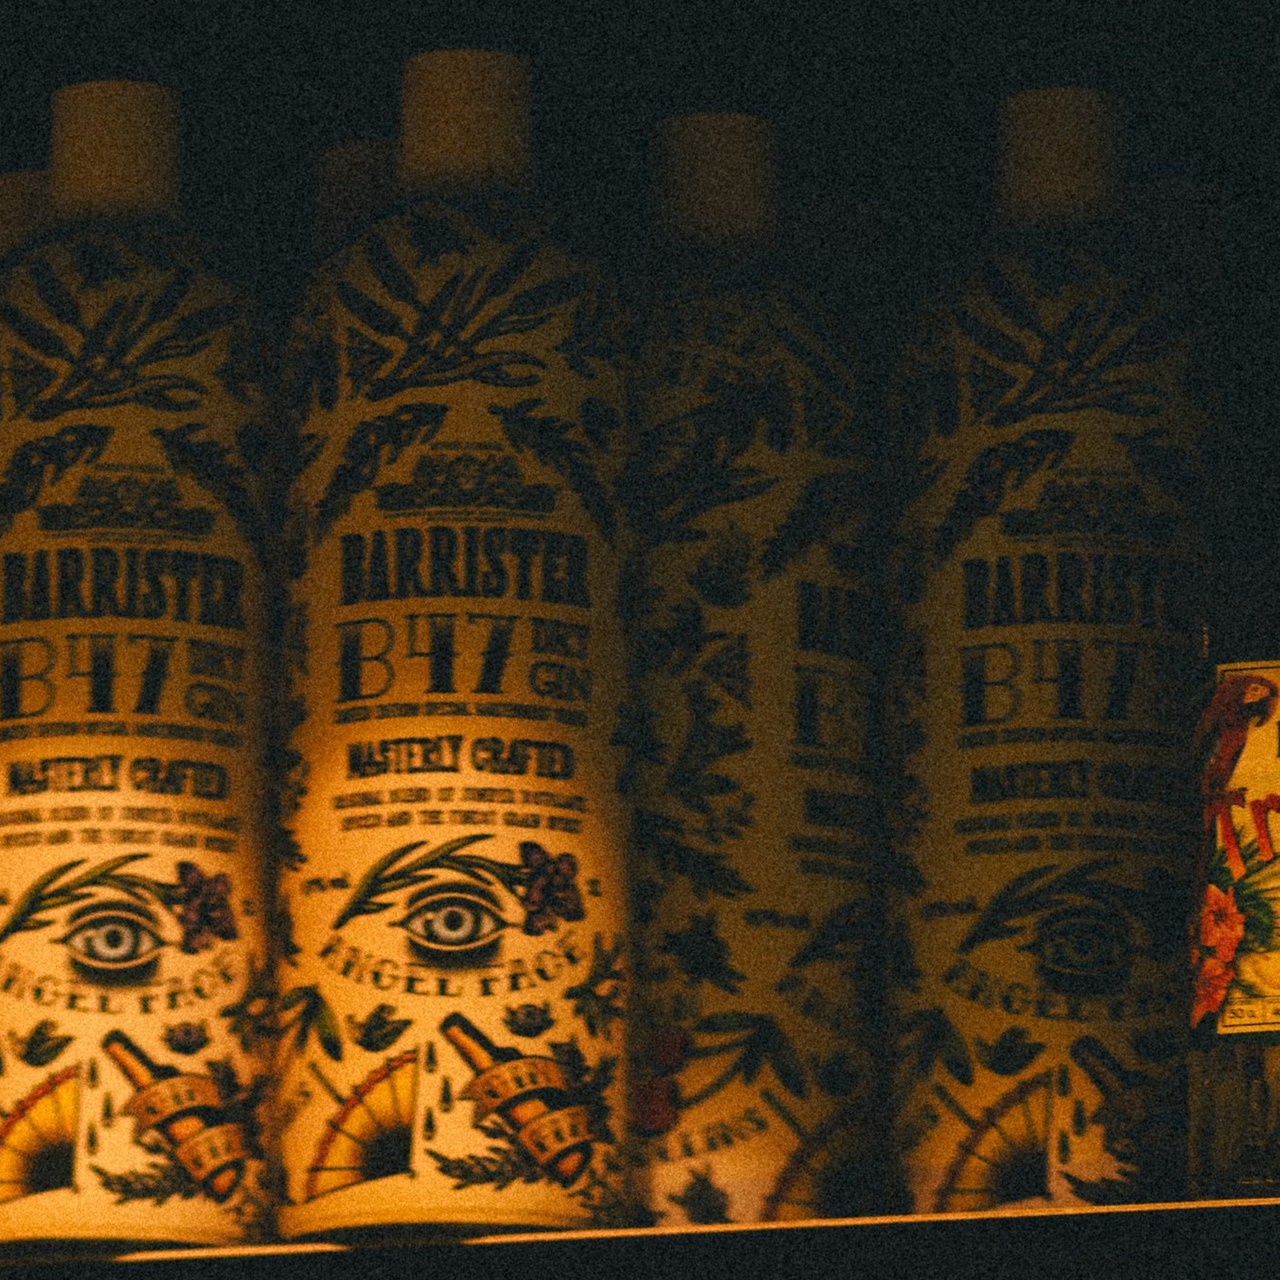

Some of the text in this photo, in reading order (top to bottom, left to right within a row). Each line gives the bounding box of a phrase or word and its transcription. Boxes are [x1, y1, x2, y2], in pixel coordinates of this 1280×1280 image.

[0, 547, 247, 630] BARRISTER
[341, 526, 592, 608] BARRISTER
[961, 552, 1184, 632] BARRIST
[336, 612, 521, 704] B47
